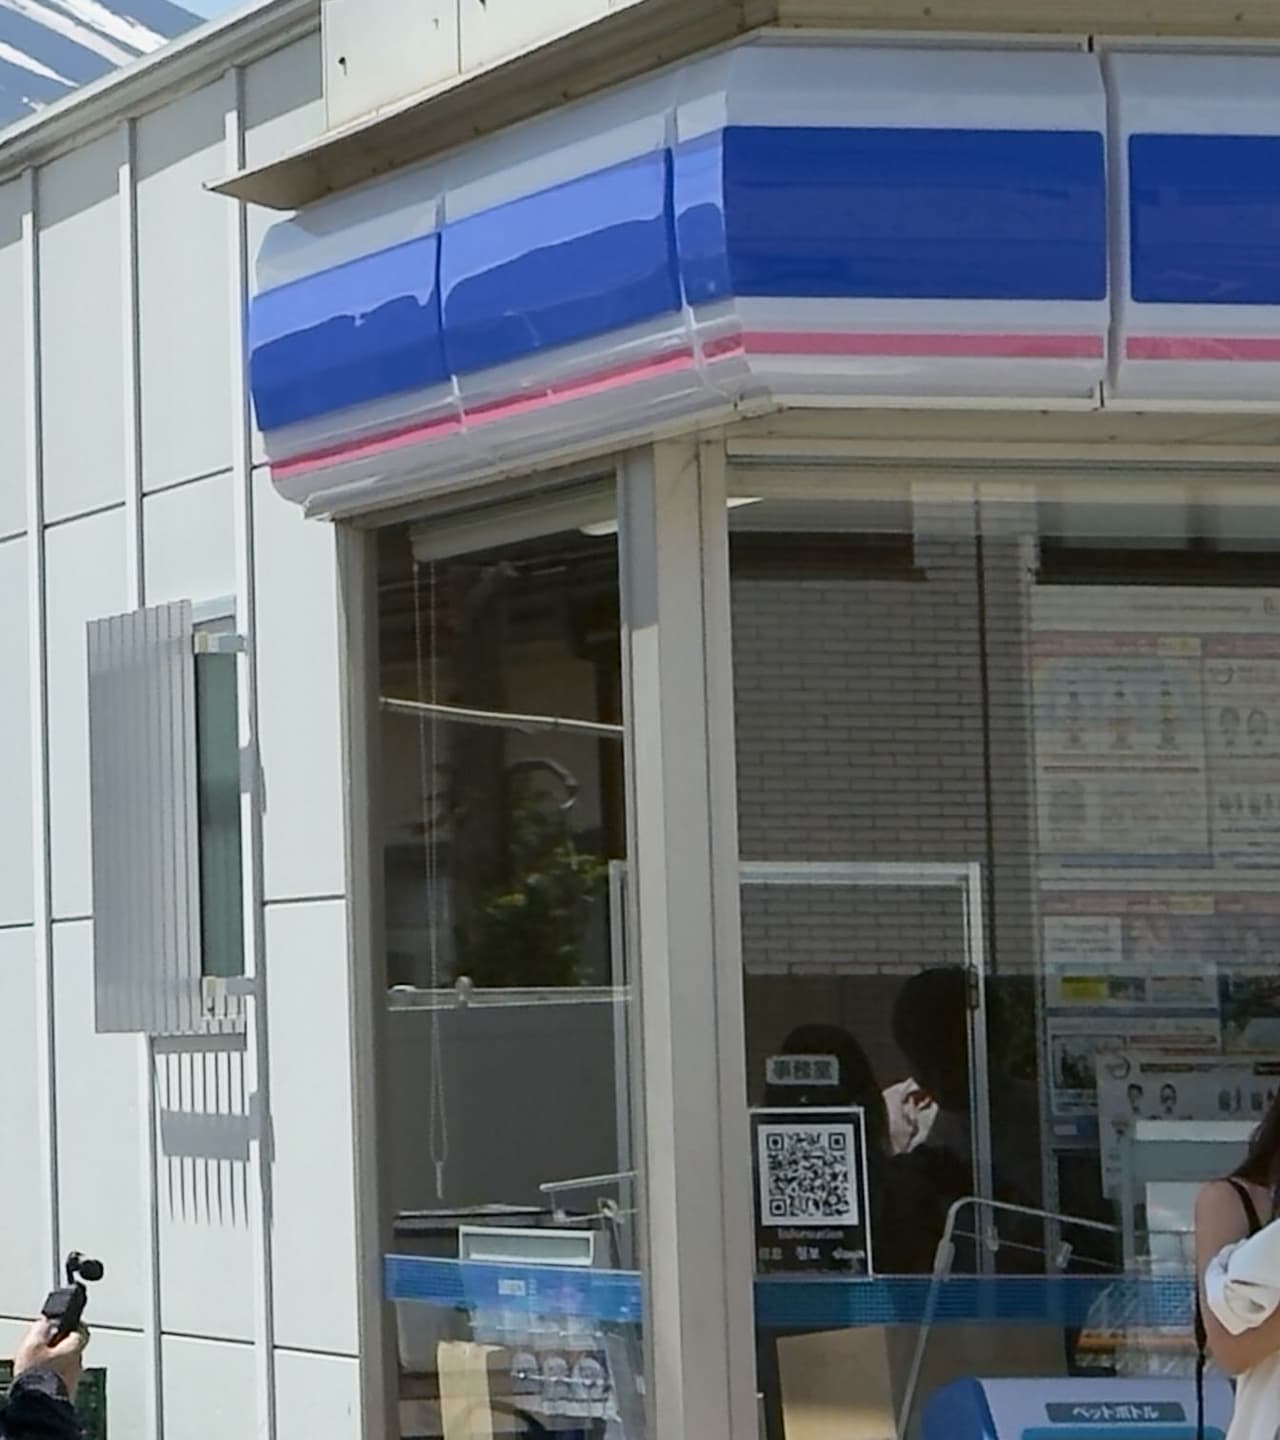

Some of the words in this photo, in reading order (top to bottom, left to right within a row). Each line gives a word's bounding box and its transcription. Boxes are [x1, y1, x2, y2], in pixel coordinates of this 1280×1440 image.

[1071, 1404, 1160, 1421] ペットボトル
